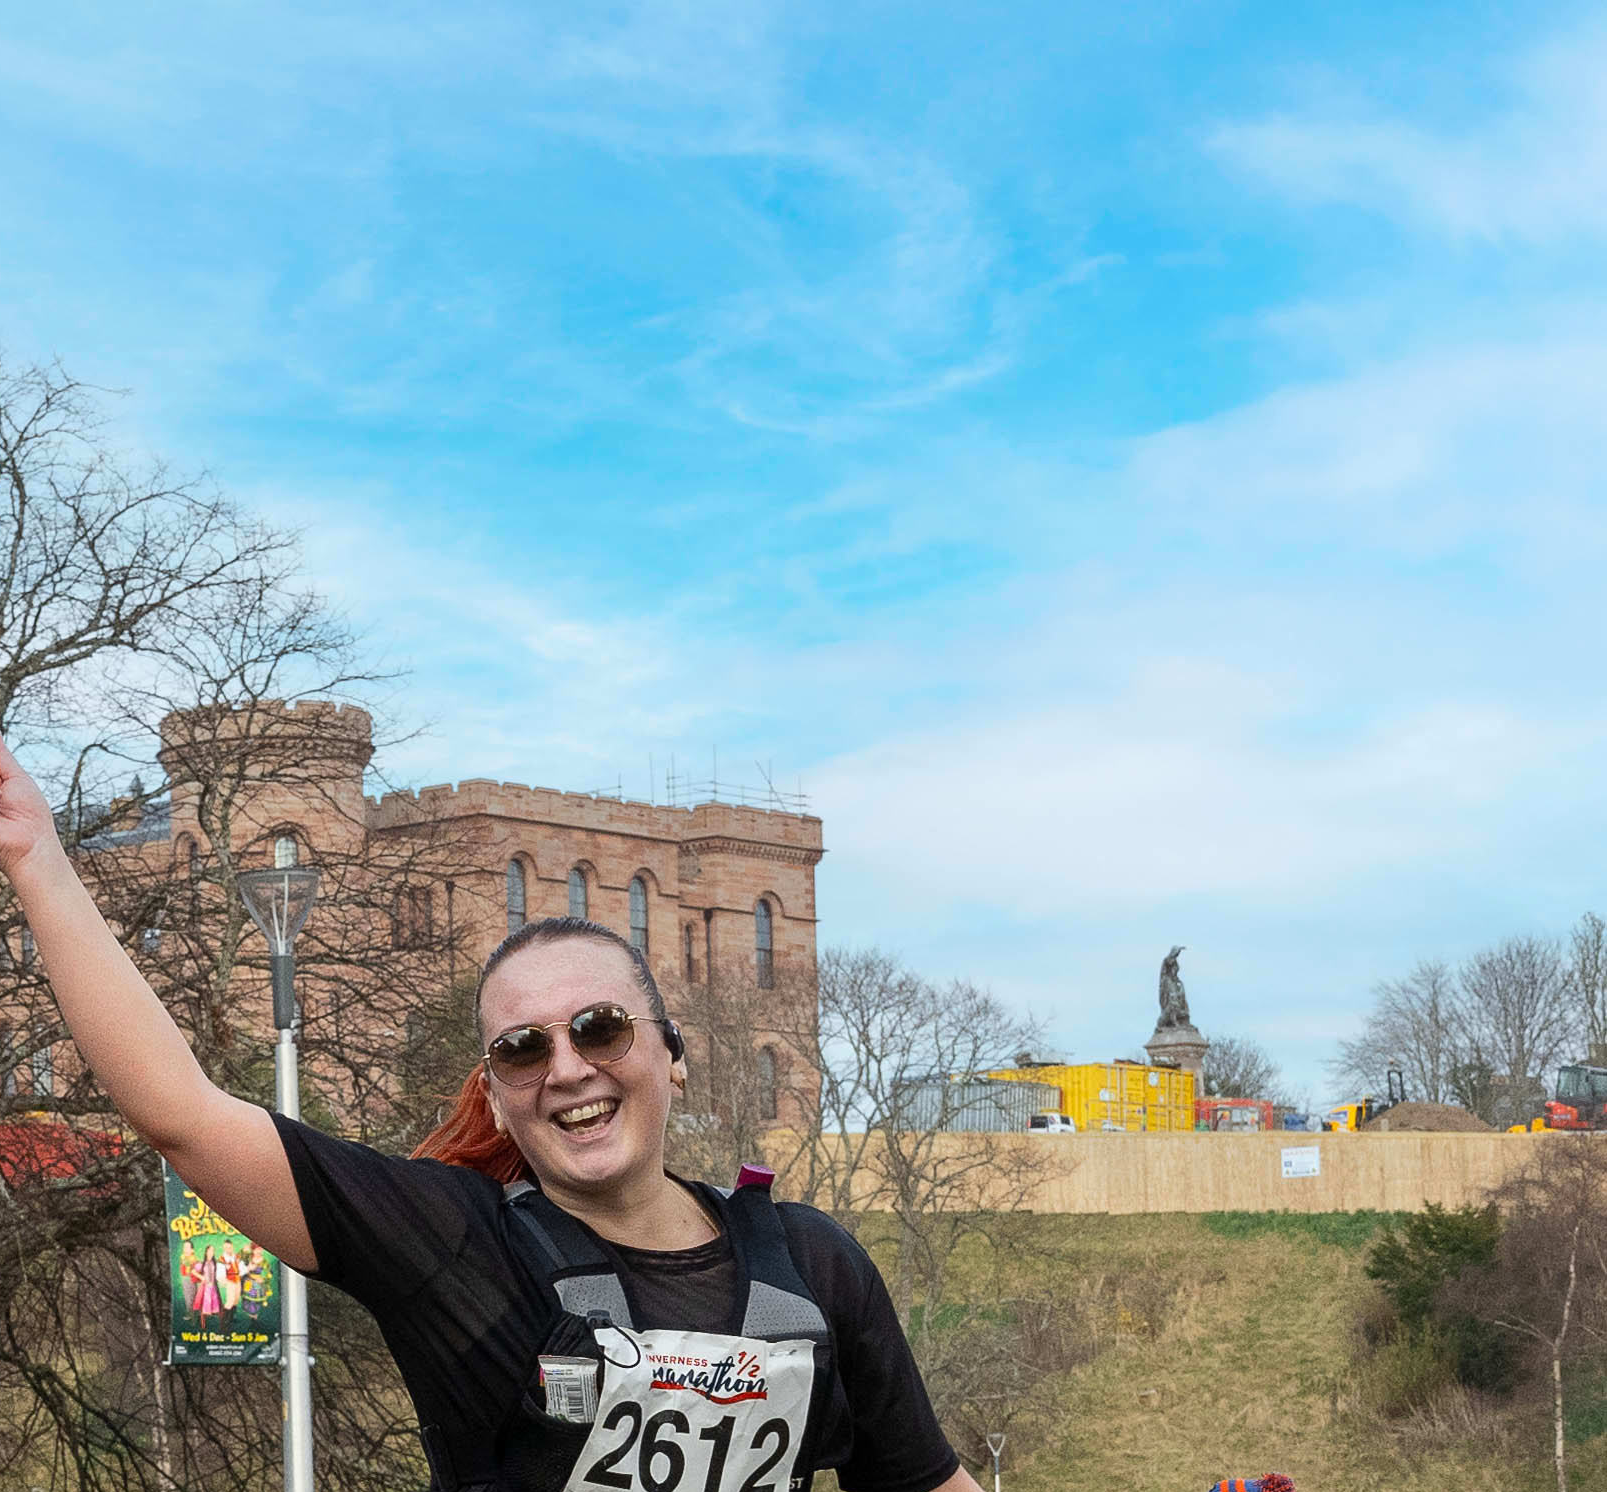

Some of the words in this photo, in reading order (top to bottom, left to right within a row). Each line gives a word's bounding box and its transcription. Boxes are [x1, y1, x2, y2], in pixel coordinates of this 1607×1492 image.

[181, 1332, 201, 1342] Wed
[201, 1332, 208, 1342] 4
[209, 1332, 225, 1342] Dec
